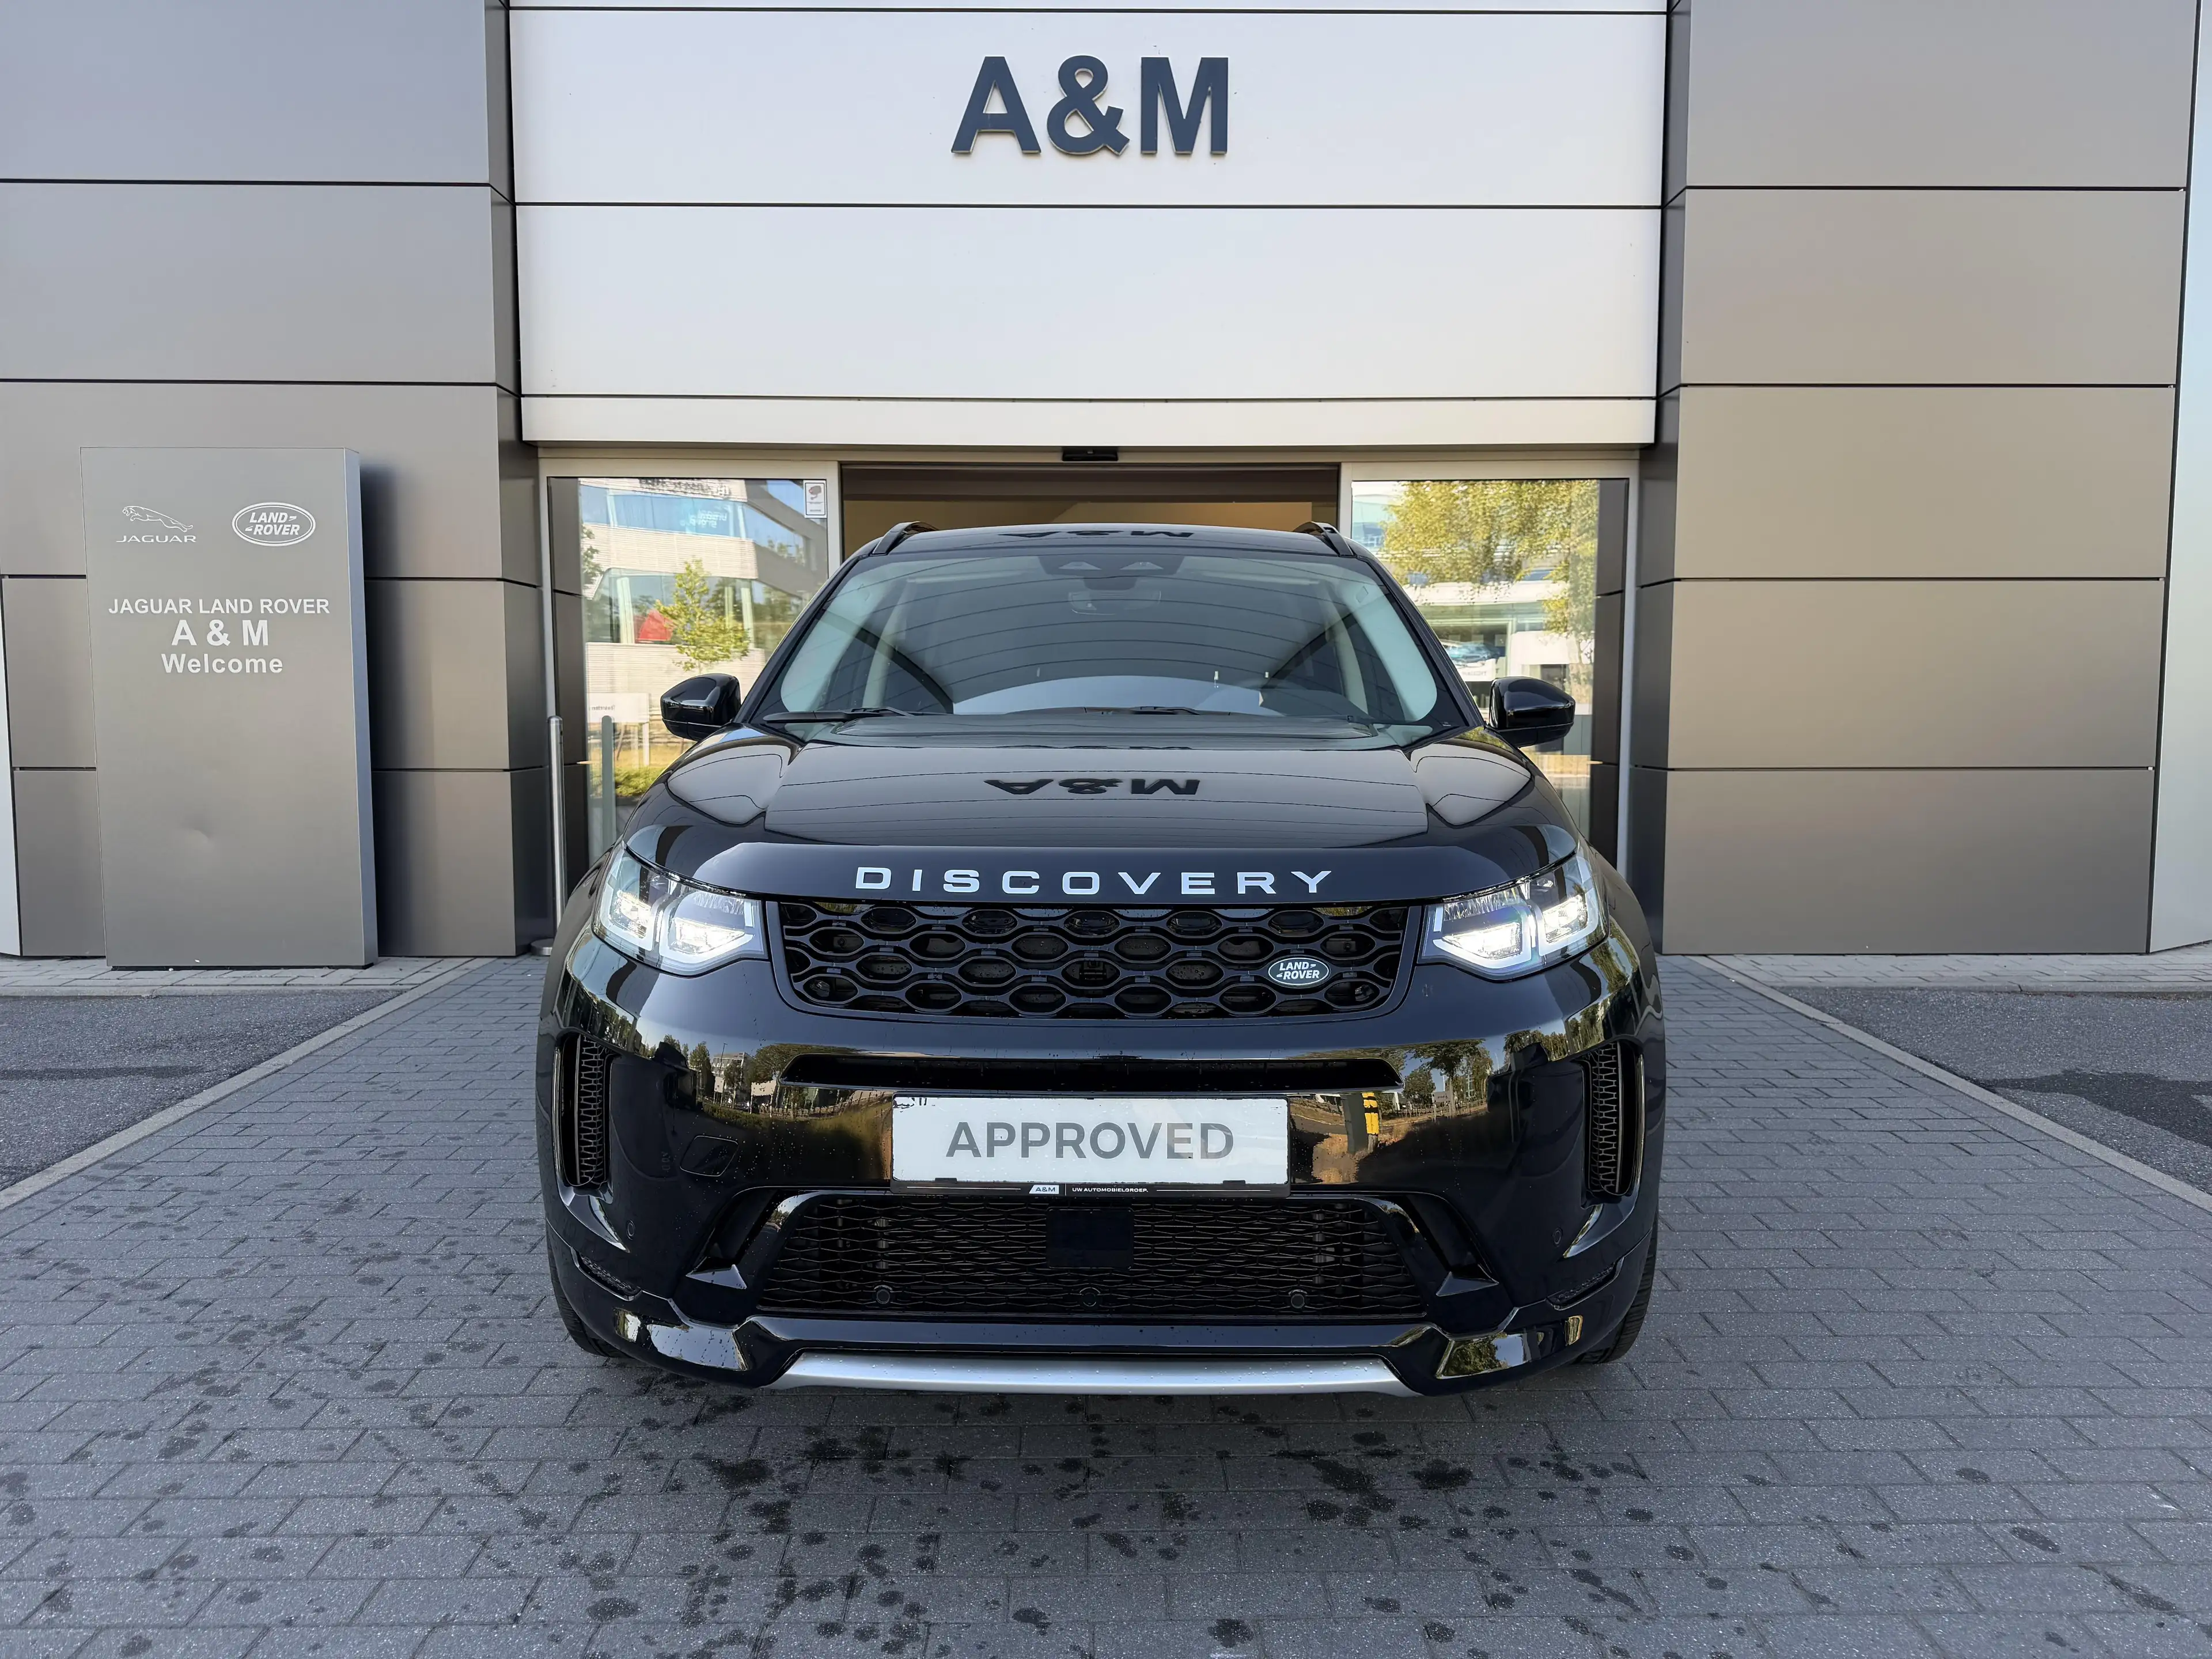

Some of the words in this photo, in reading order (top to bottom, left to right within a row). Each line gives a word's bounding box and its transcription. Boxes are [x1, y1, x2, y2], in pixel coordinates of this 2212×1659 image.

[950, 55, 1229, 156] A&M
[249, 512, 289, 524] LAND
[252, 524, 300, 536] ROVER
[116, 535, 196, 543] JAGUAR
[108, 599, 192, 614] JAGUAR
[199, 599, 253, 614] LAND
[260, 599, 330, 614] ROVER
[171, 619, 197, 646] A
[206, 619, 231, 646] &
[242, 619, 268, 646] M
[161, 653, 283, 673] Welcome
[855, 866, 1332, 896] DISCOVERY
[1279, 961, 1309, 971] LAND
[1283, 969, 1320, 980] ROVER
[946, 1121, 1234, 1160] APPROVED
